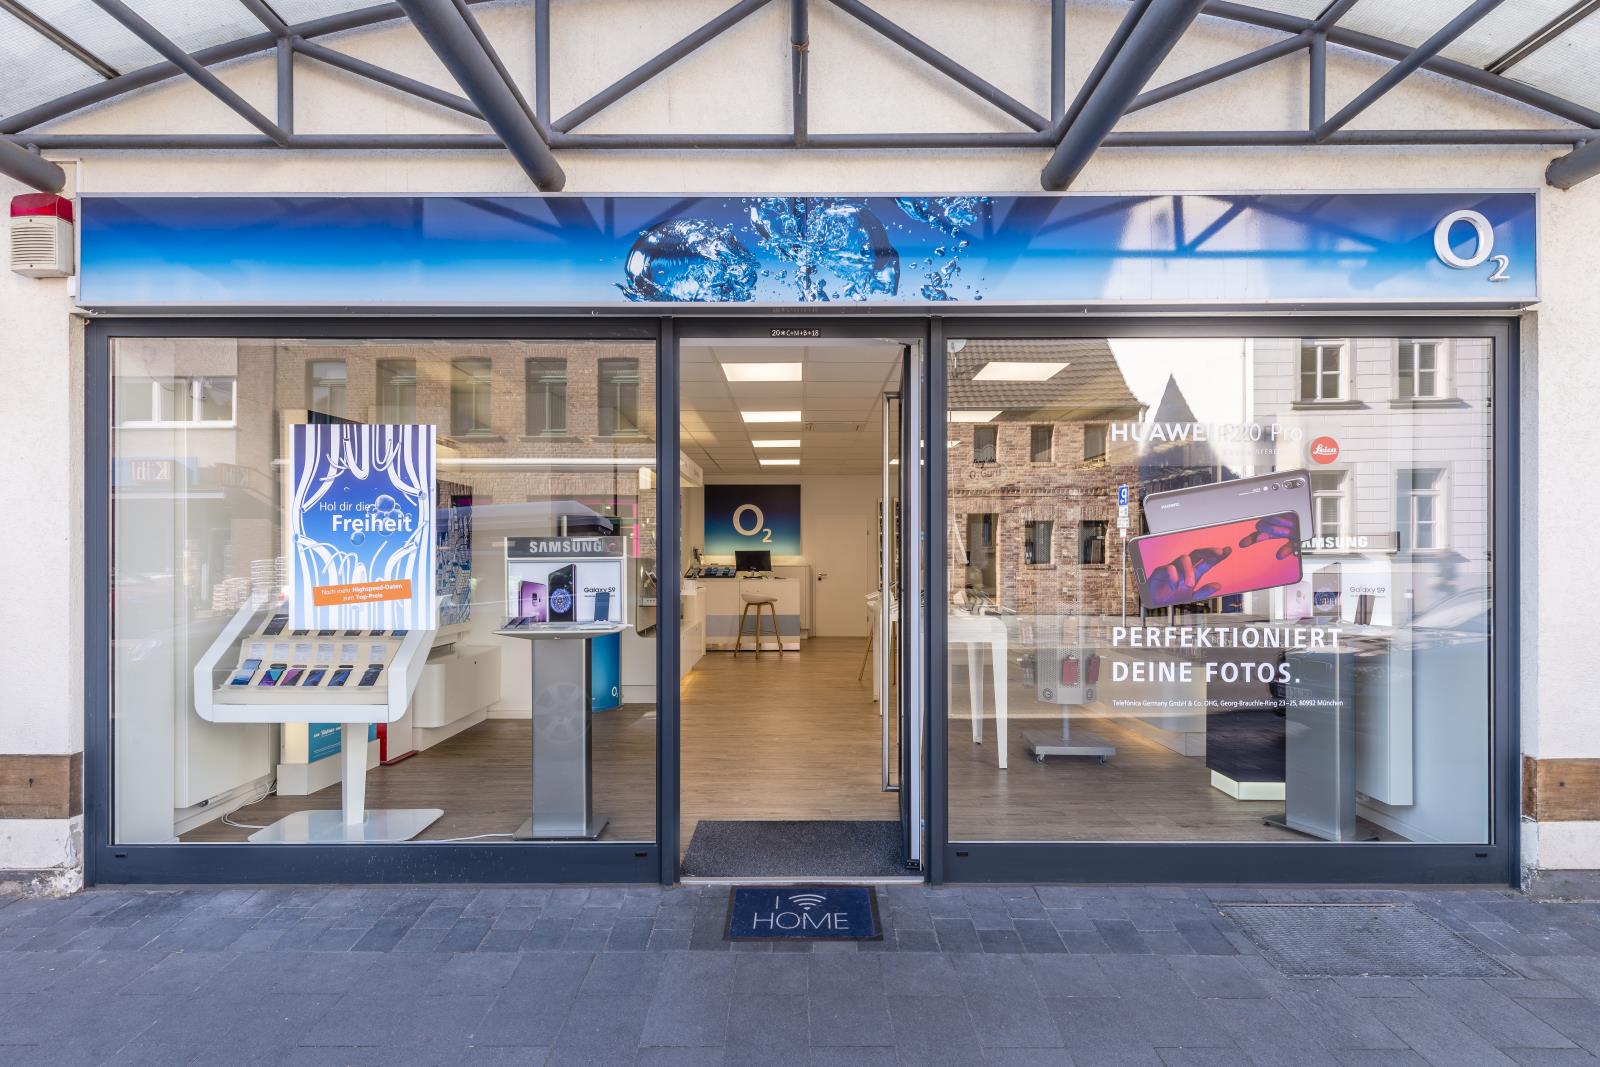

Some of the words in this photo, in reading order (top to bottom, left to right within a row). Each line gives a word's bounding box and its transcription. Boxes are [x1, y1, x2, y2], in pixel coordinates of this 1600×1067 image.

[1433, 208, 1511, 282] O2
[1271, 423, 1302, 442] Pro
[1312, 443, 1338, 456] Leica
[319, 502, 336, 511] Hol
[339, 502, 352, 511] dir
[356, 502, 370, 511] die
[332, 514, 412, 532] Freiheit
[732, 504, 772, 543] O2
[529, 540, 602, 553] SAMSUNG
[1302, 536, 1368, 548] AMSUNG
[1349, 586, 1375, 594] Galaxy
[1112, 626, 1343, 649] PERFEKTIONIERT
[1112, 662, 1192, 683] DEINE
[1206, 662, 1300, 683] FOTOS.
[1142, 700, 1168, 708] Germany
[1317, 699, 1344, 707] München
[775, 896, 779, 909] I
[752, 911, 849, 930] HOME
